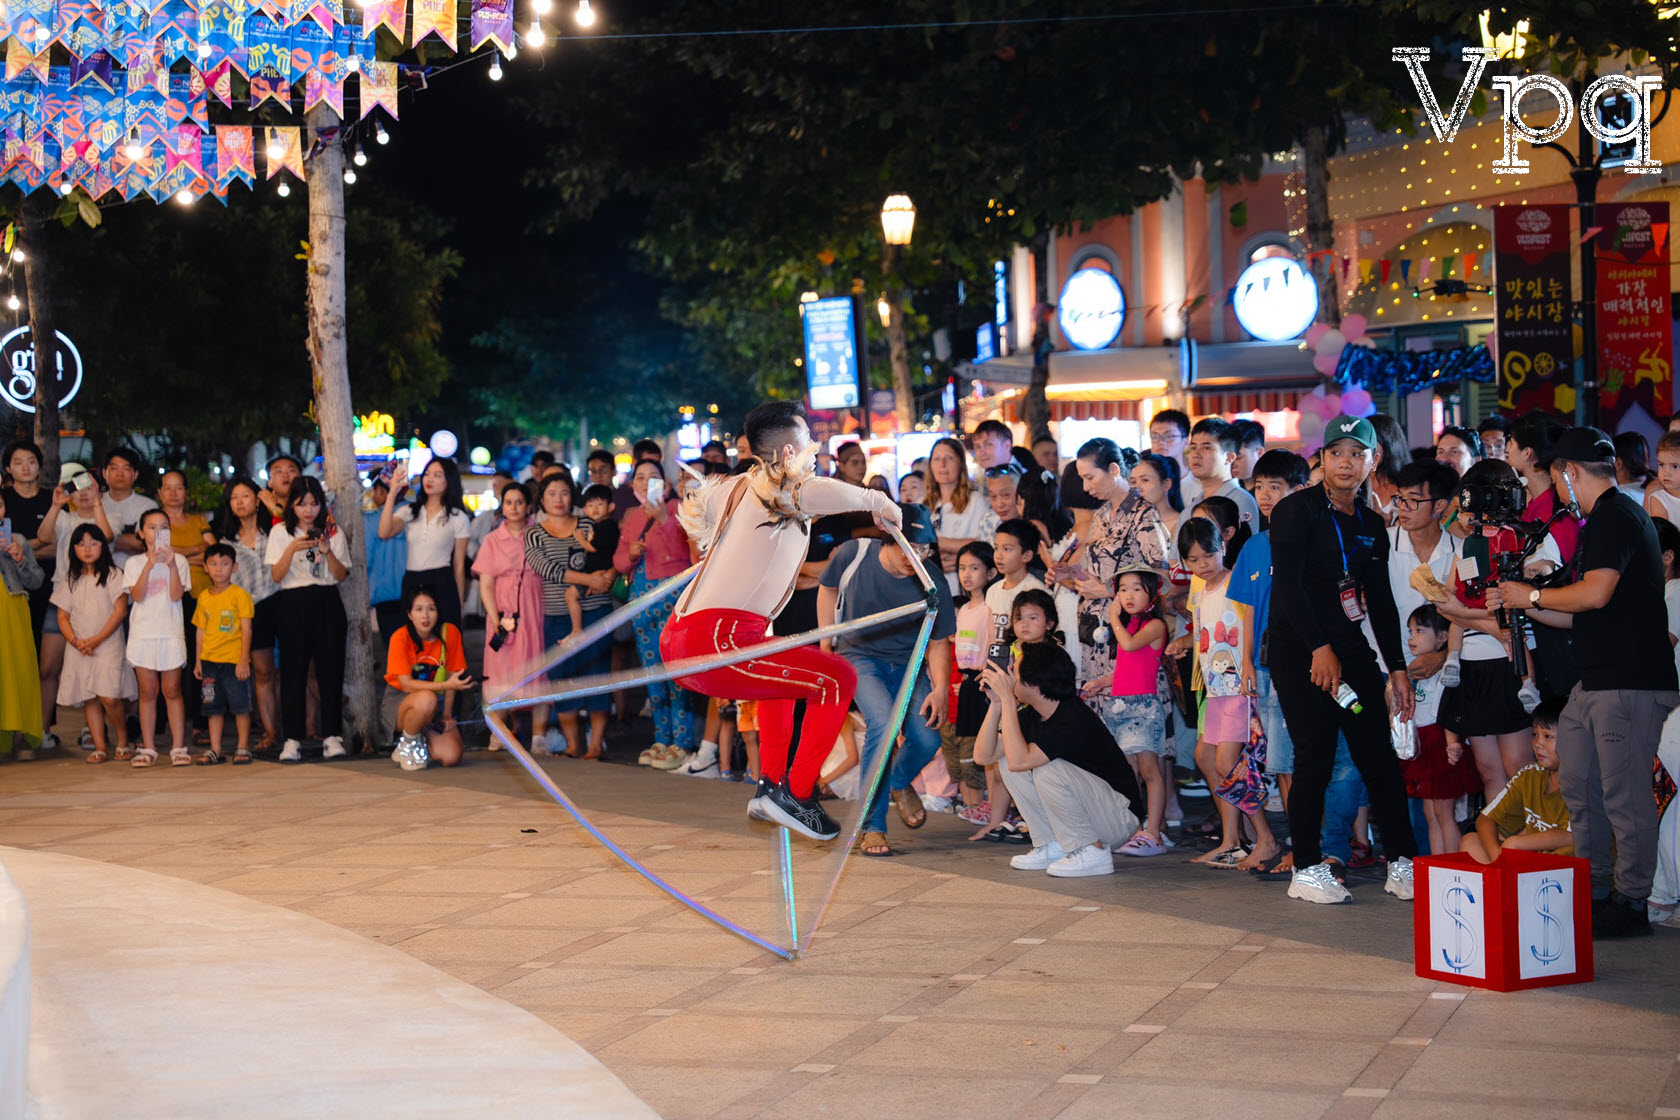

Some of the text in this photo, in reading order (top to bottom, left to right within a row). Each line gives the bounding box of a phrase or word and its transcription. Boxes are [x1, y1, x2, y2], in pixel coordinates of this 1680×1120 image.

[260, 67, 283, 79] PHE
[1505, 276, 1563, 300] 맛있는
[1616, 278, 1648, 297] 가장
[1504, 300, 1565, 323] 야시장
[1602, 295, 1665, 315] 매력적인
